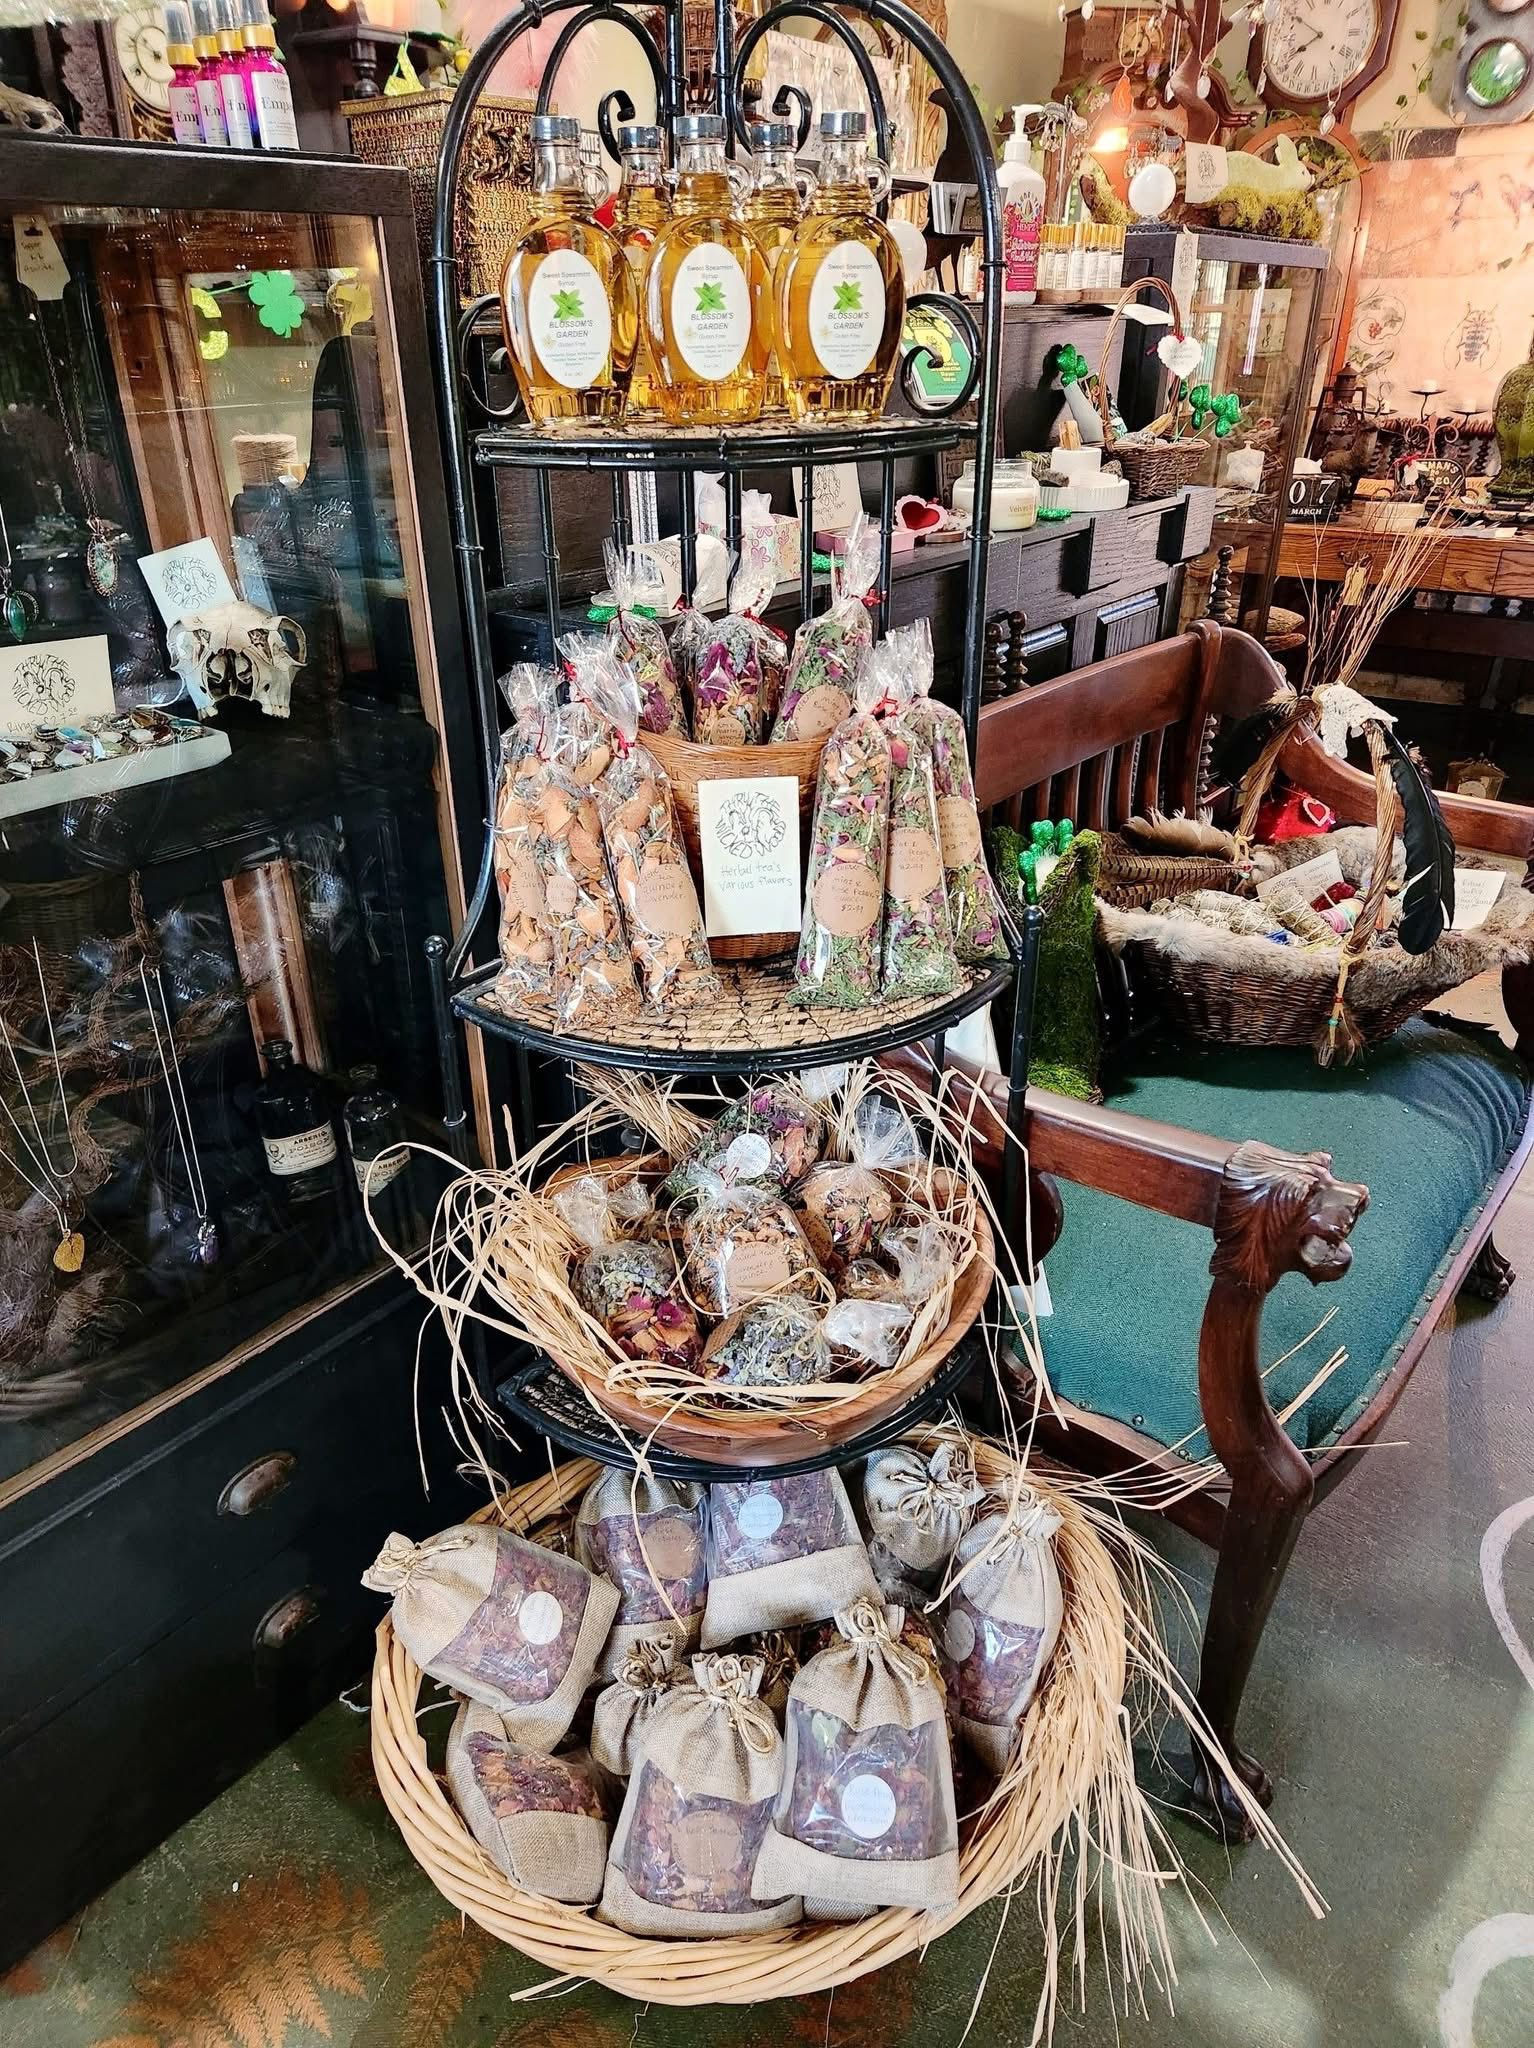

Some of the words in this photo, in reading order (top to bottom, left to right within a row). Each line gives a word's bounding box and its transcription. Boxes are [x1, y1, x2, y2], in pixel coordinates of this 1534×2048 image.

[690, 312, 734, 321] BLOSSOM'S
[827, 311, 870, 320] BLOSSOM'S
[549, 320, 593, 329] BLOSSOM'S
[697, 323, 728, 331] GARDEN
[833, 322, 864, 330] GARDEN
[556, 330, 589, 339] GARDEN
[715, 818, 753, 859] WICKED
